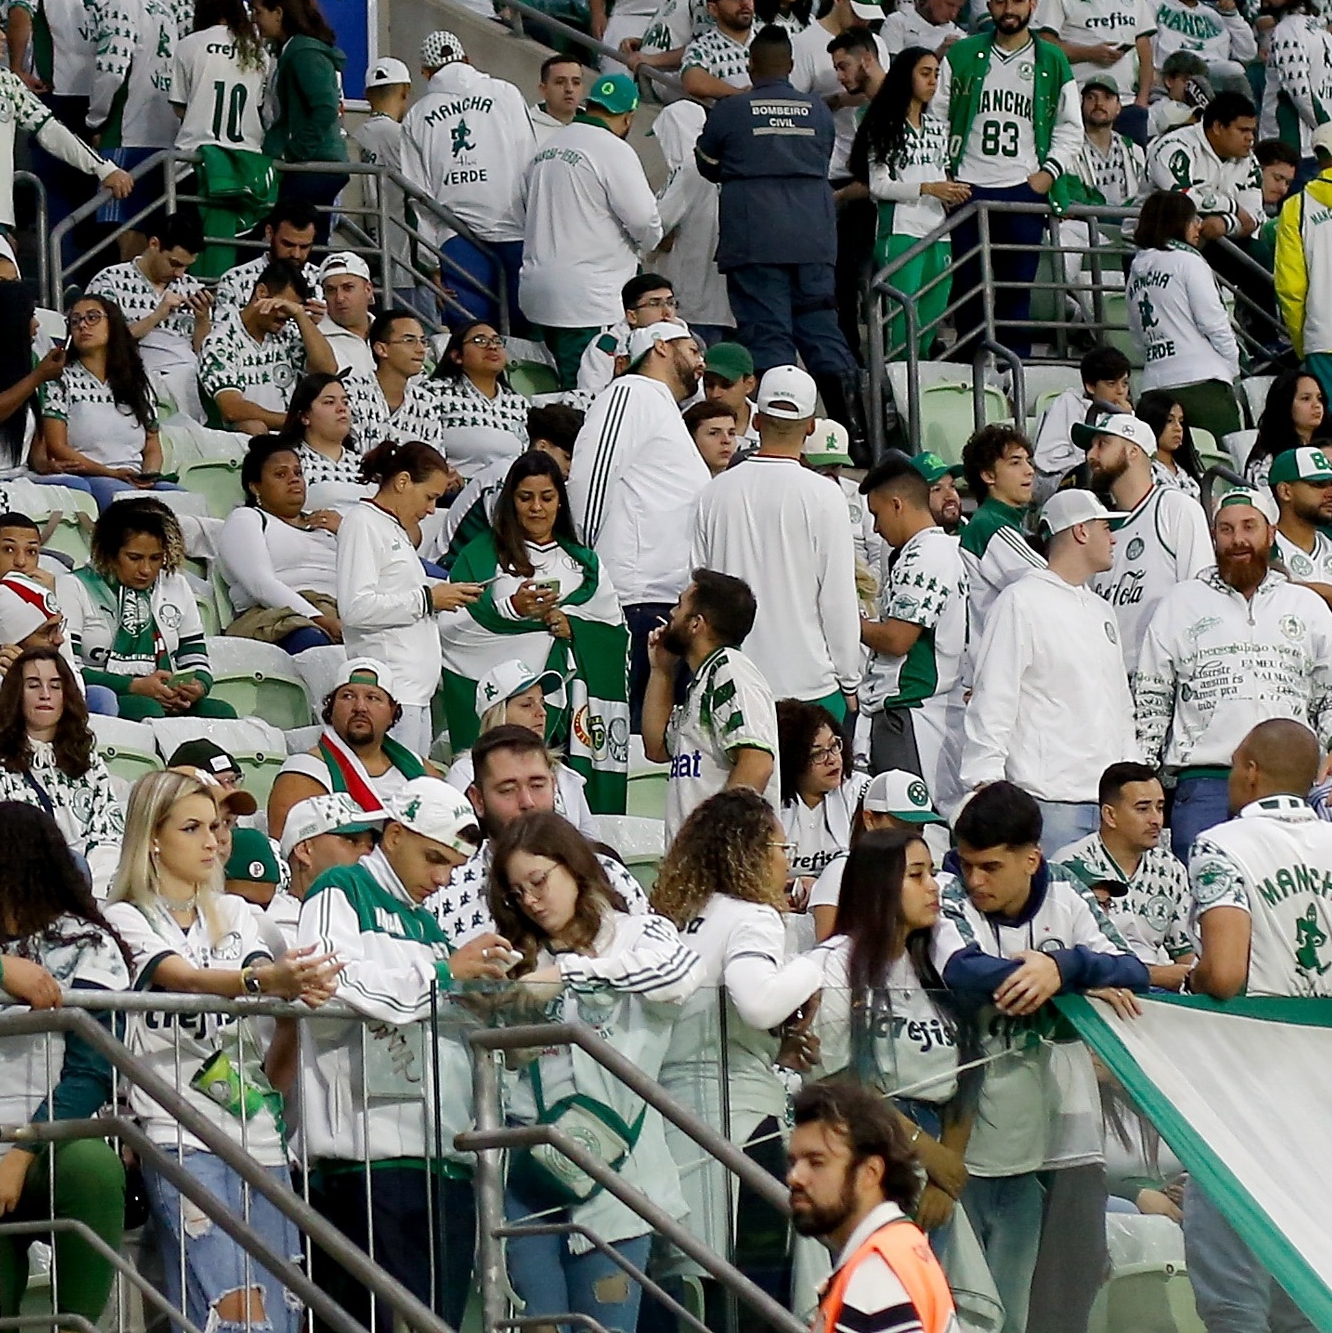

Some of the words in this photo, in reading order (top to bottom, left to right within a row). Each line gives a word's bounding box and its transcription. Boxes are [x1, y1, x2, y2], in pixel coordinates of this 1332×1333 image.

[1085, 12, 1136, 32] crefisa
[213, 81, 247, 144] 10
[425, 96, 493, 126] MANCHA
[751, 106, 809, 117] BOMBEIRO
[768, 116, 796, 128] CIVIL
[981, 119, 1020, 157] 83
